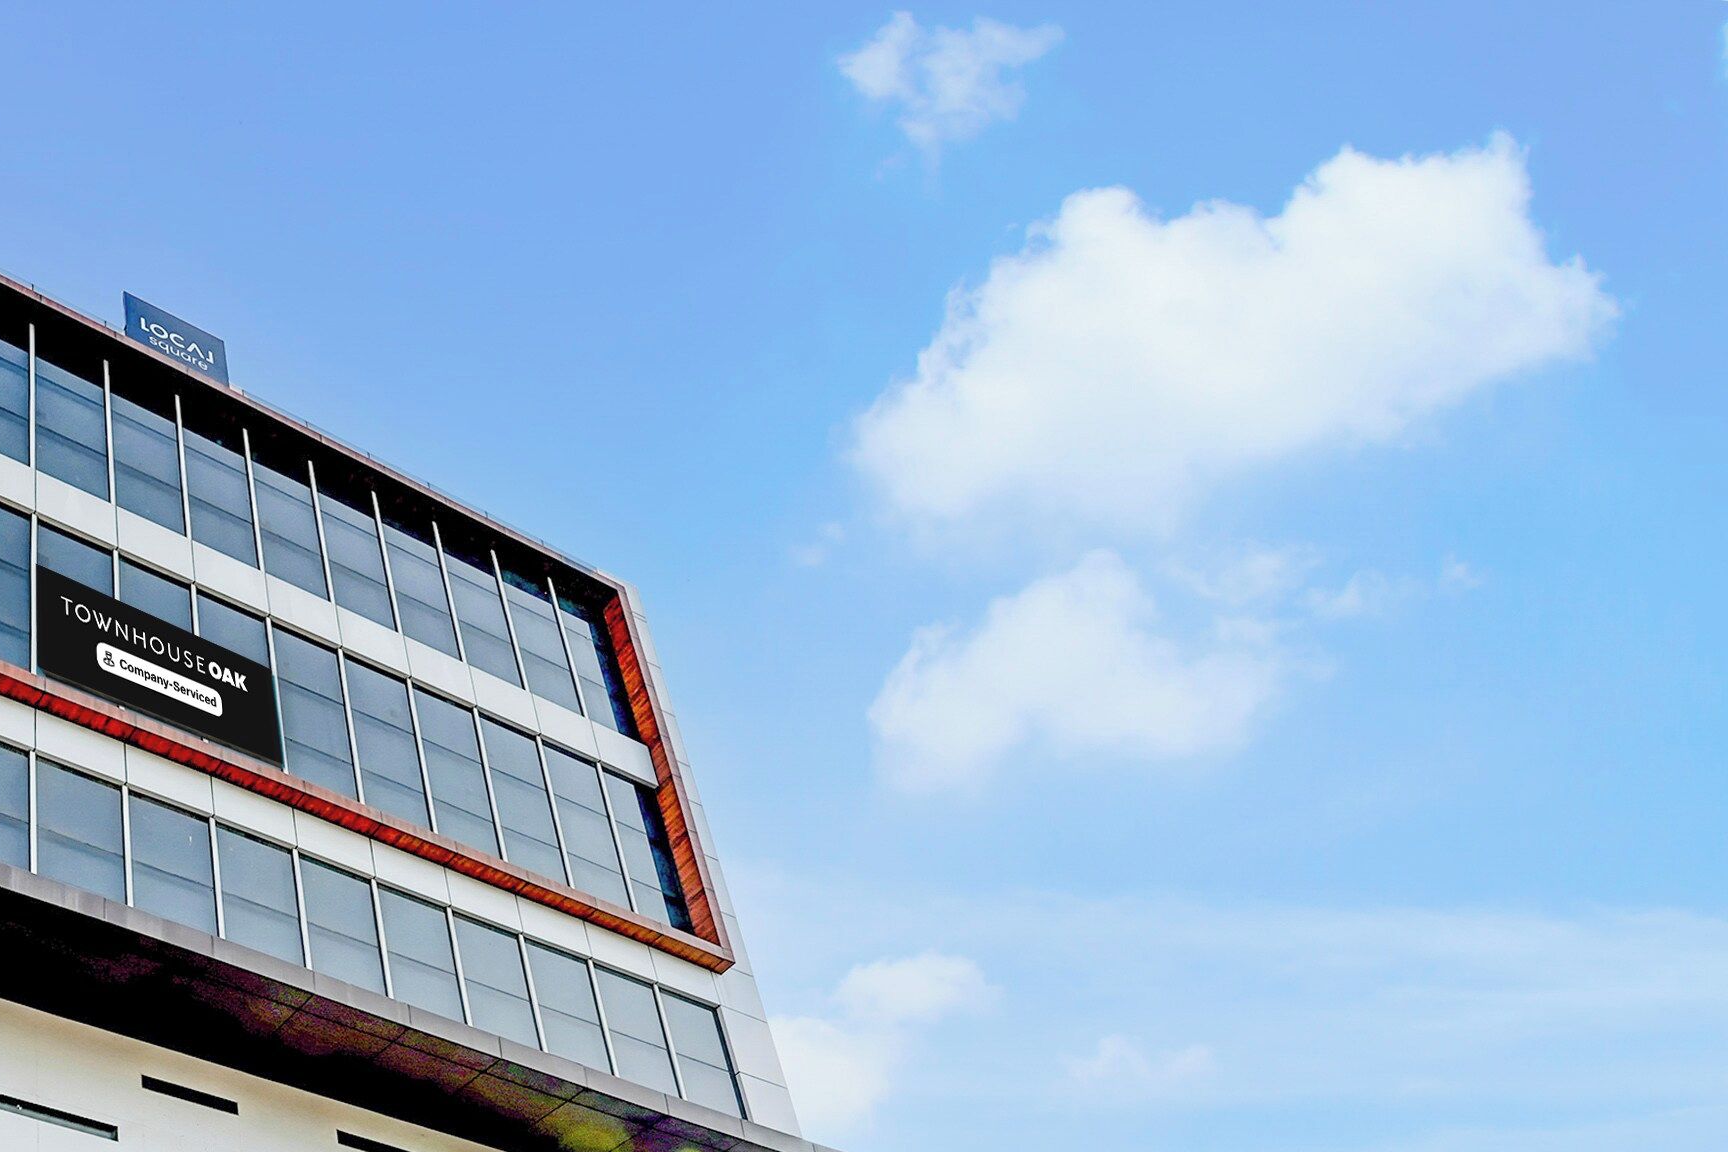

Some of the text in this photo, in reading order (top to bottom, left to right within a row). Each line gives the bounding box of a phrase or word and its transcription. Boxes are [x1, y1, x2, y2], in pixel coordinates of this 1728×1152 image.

[139, 317, 214, 364] LOCAL
[149, 336, 208, 371] square
[119, 659, 217, 708] Company-Serviced
